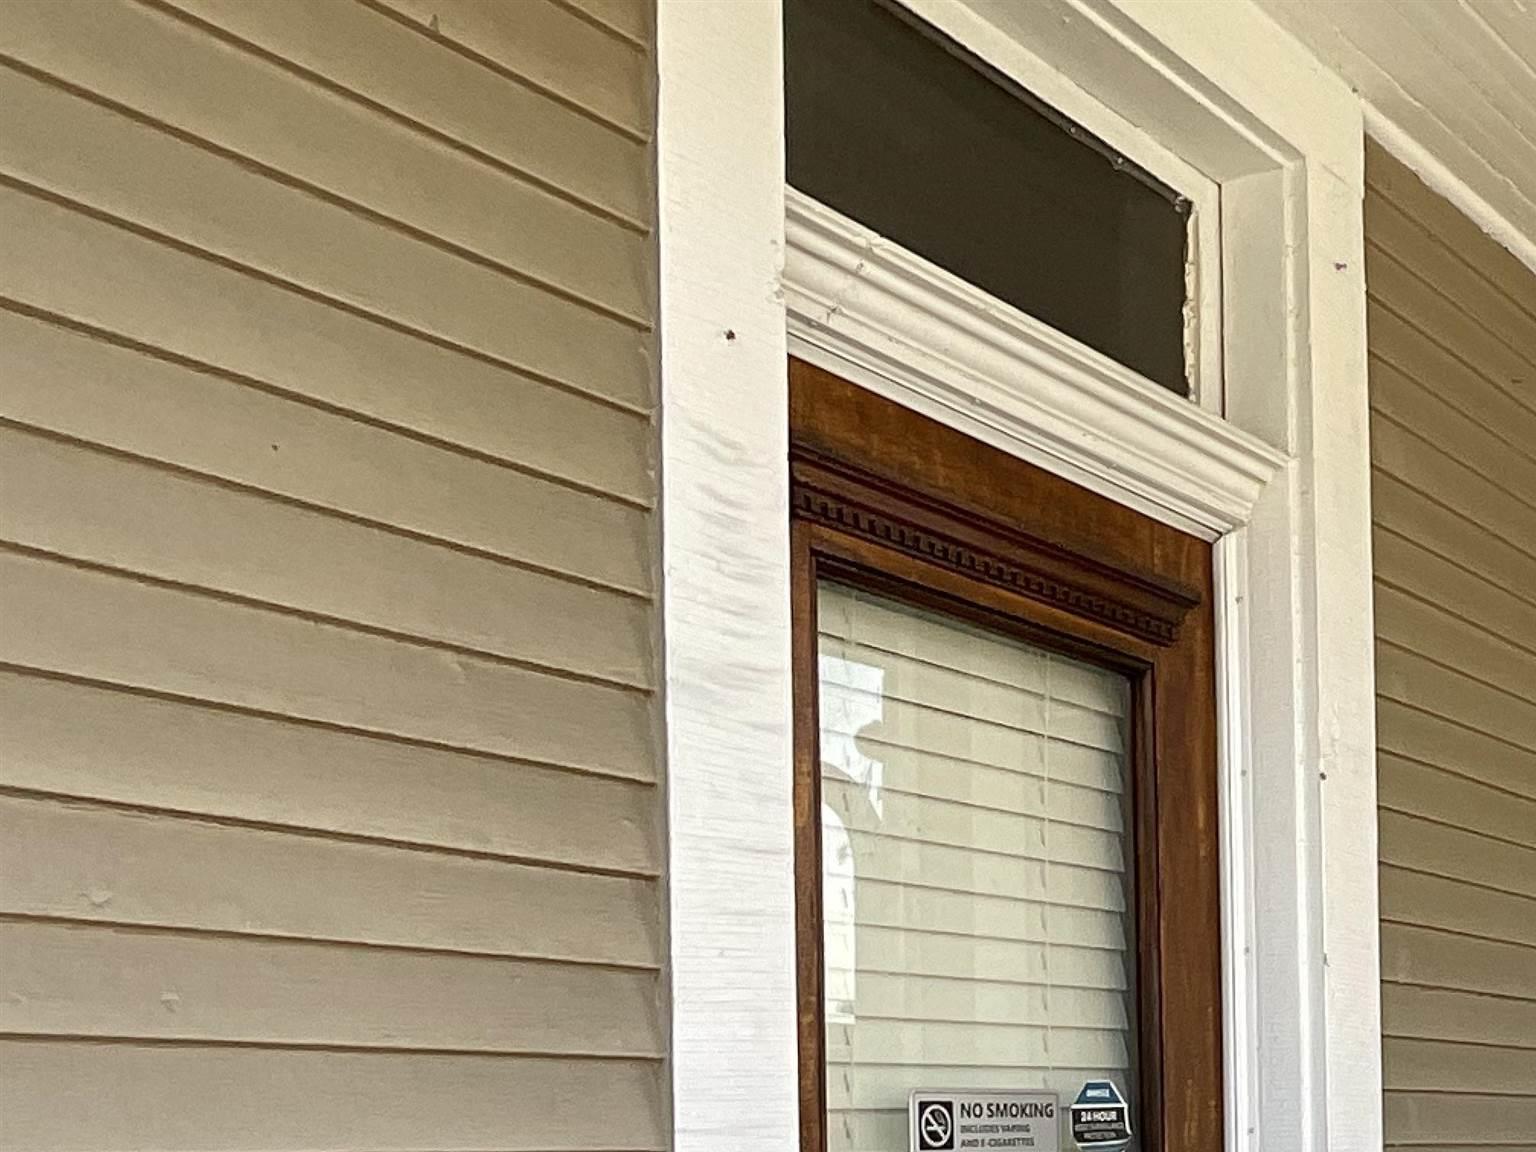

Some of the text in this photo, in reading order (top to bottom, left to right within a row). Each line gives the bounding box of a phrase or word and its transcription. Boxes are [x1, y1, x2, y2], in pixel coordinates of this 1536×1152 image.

[960, 1103, 1055, 1119] NO SMOKING
[1080, 1111, 1117, 1122] 24 HOUR
